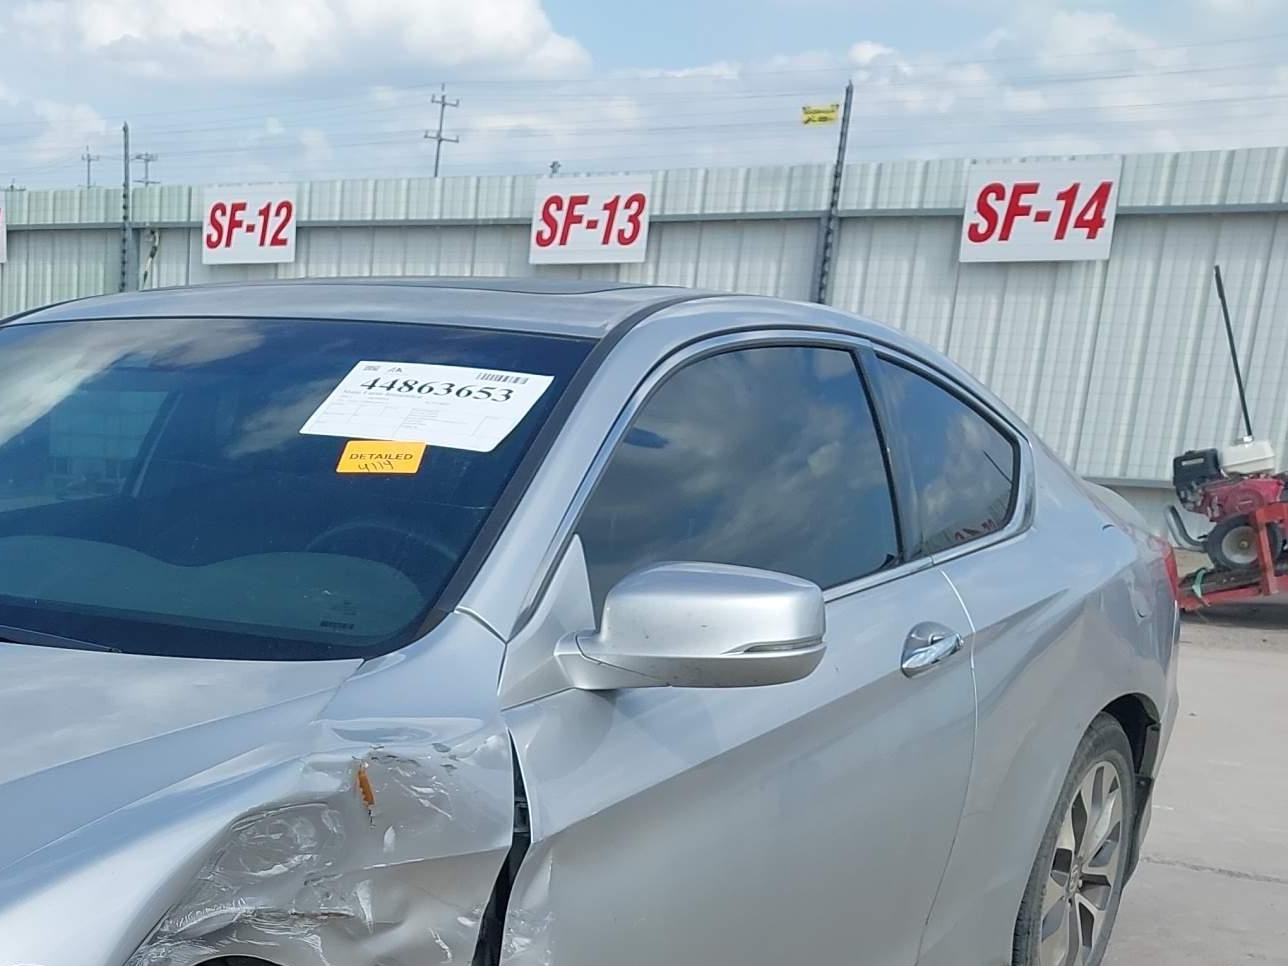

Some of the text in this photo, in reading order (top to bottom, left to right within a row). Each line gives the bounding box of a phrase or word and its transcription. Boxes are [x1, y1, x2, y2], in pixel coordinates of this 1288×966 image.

[206, 200, 294, 250] SF-12
[536, 193, 647, 248] SF-13
[968, 181, 1114, 243] SF-14
[360, 376, 514, 402] 44863653
